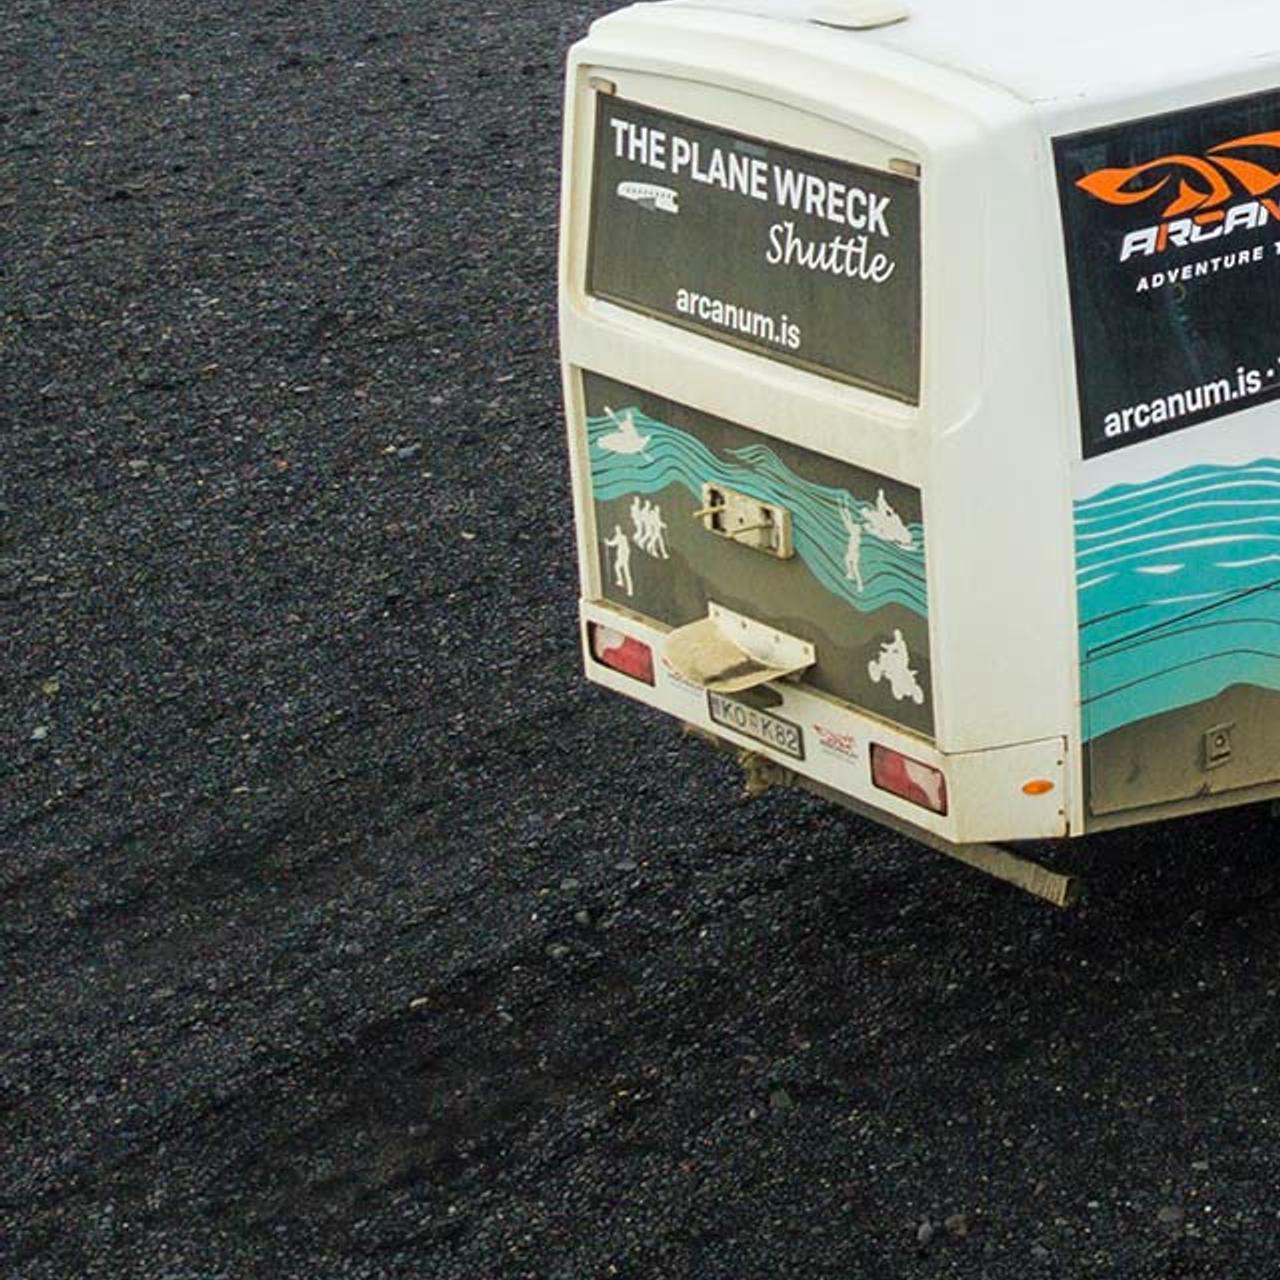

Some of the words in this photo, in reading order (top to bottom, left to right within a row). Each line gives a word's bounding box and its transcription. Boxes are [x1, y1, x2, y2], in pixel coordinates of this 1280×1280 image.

[610, 117, 667, 170] THE
[671, 137, 769, 201] PLANE
[773, 165, 891, 237] WRECK
[766, 221, 895, 284] Shuttle
[1135, 245, 1265, 293] ADVENTURE
[676, 287, 801, 350] arcanum.is
[1104, 365, 1262, 438] arcanum.is
